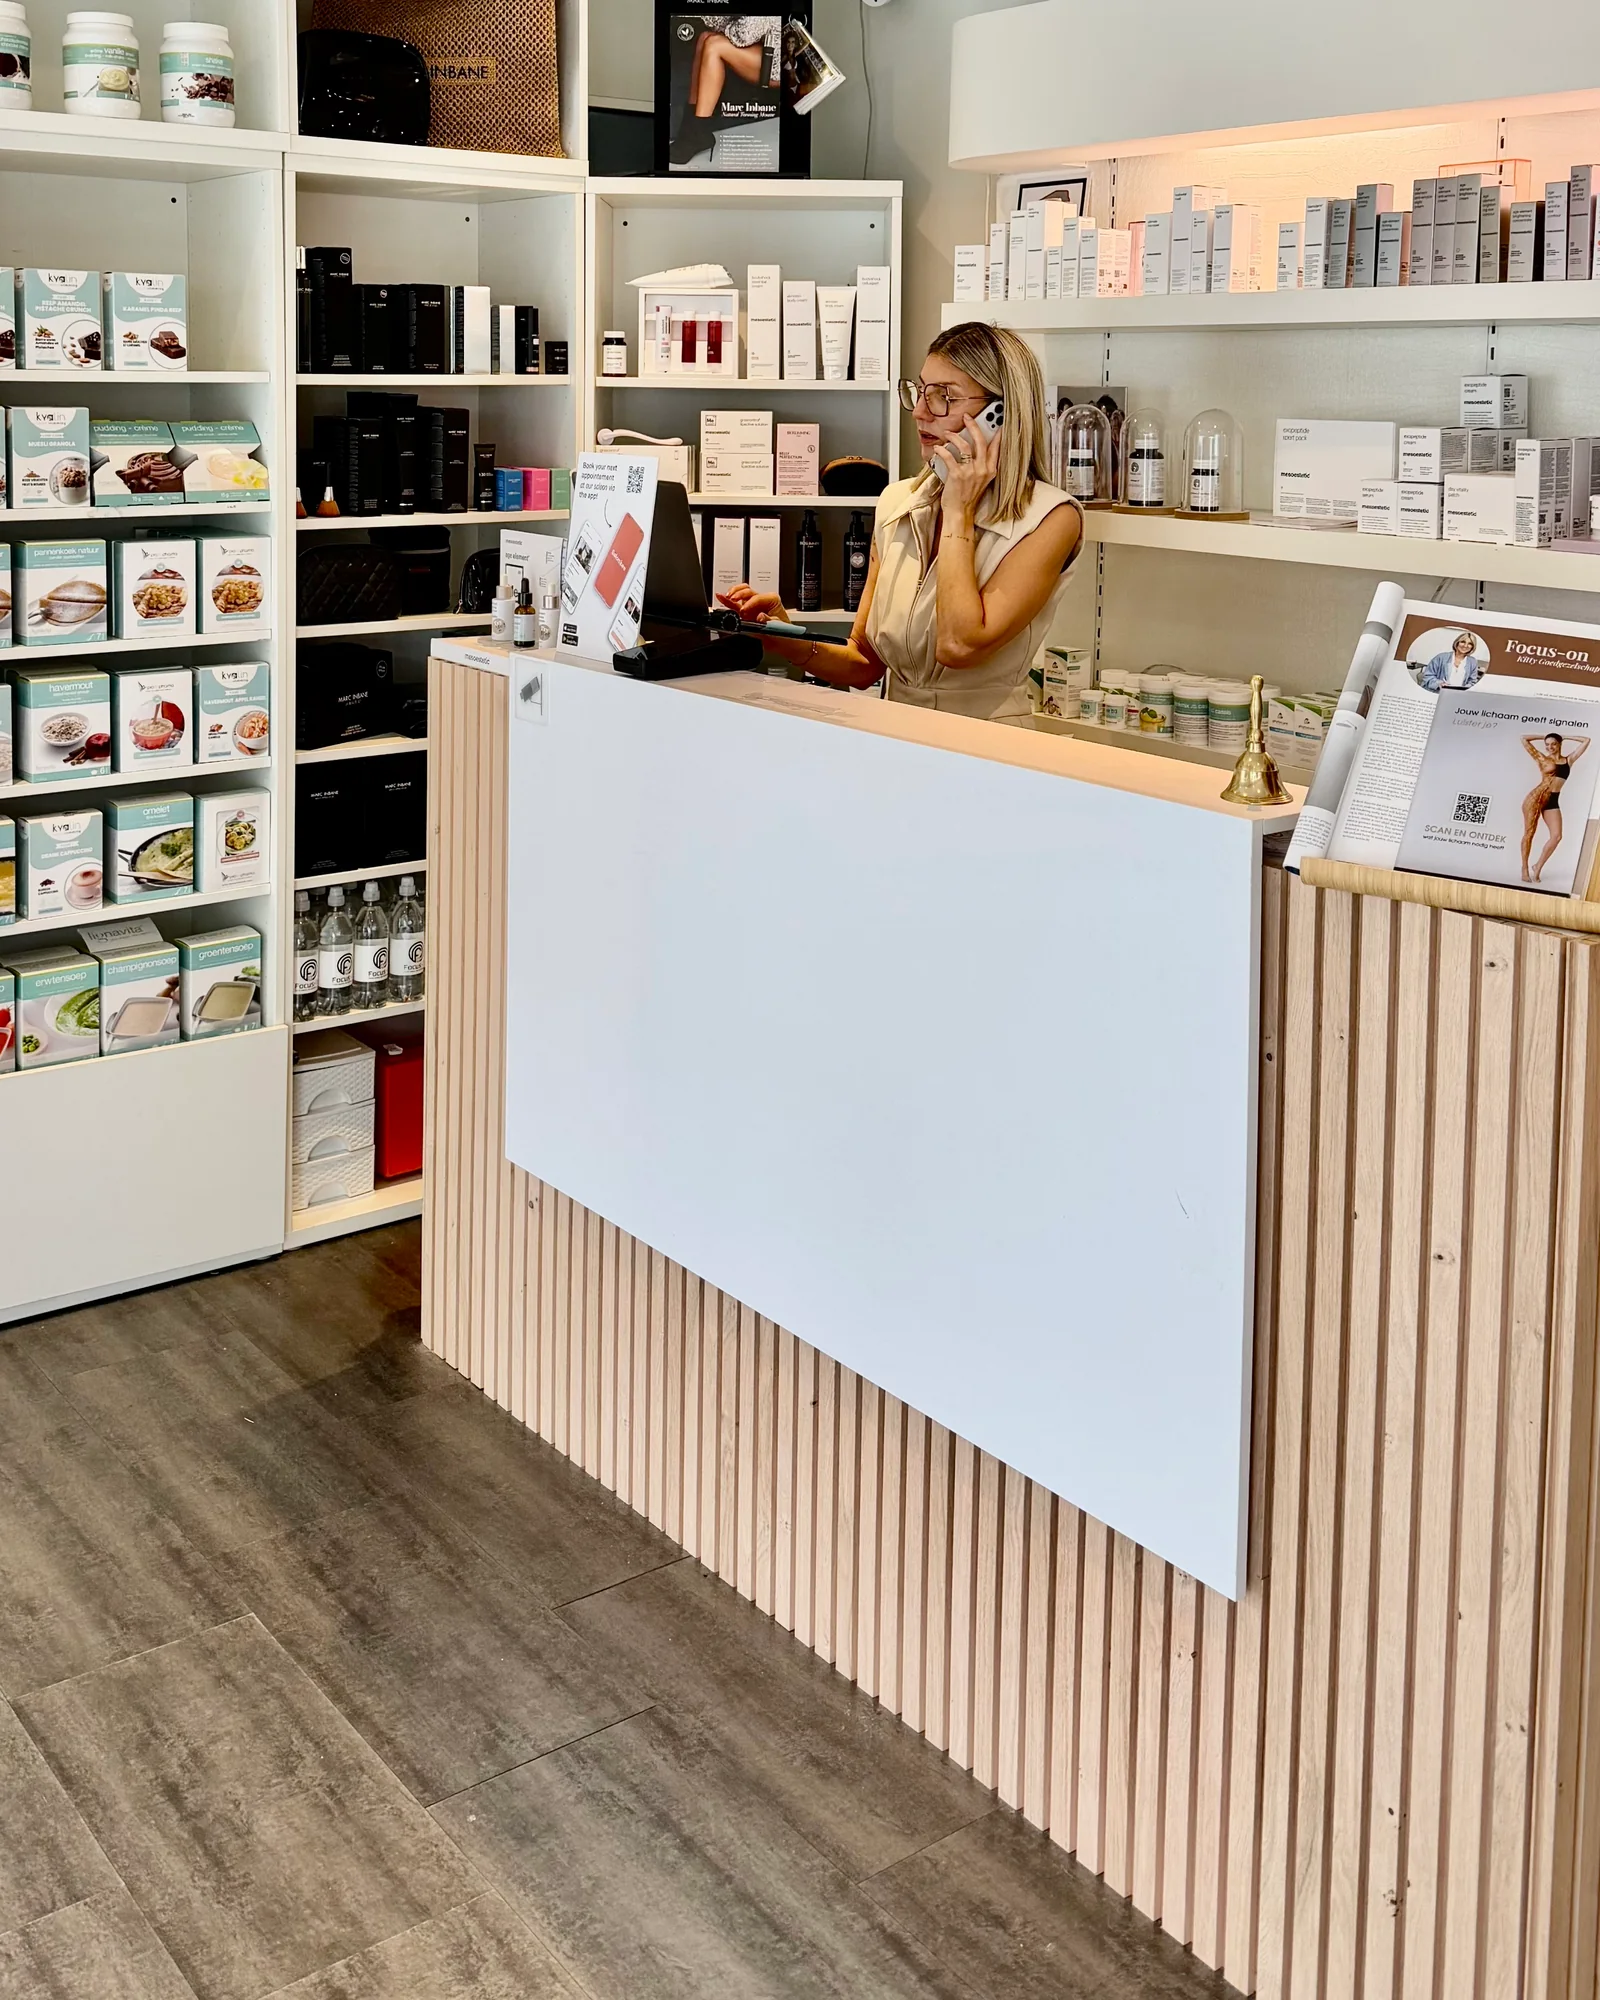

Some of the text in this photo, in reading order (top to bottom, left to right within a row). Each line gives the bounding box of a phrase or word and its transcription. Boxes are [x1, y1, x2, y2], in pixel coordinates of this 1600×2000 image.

[721, 102, 777, 112] Marc Inbane
[34, 548, 77, 557] pannenkoek
[1516, 655, 1537, 665] Kitty
[48, 681, 94, 692] havermout
[1454, 707, 1589, 729] Jouw lichaam geeft signalen
[142, 805, 170, 816] omelet
[1424, 824, 1507, 843] SCAN EN ONTDEK
[1448, 837, 1472, 846] lichaam
[1472, 841, 1489, 849] nodig
[87, 924, 141, 943] lignavita
[198, 942, 254, 961] groentensoep
[107, 956, 177, 975] champignonsoep
[35, 971, 87, 987] erwtensoep
